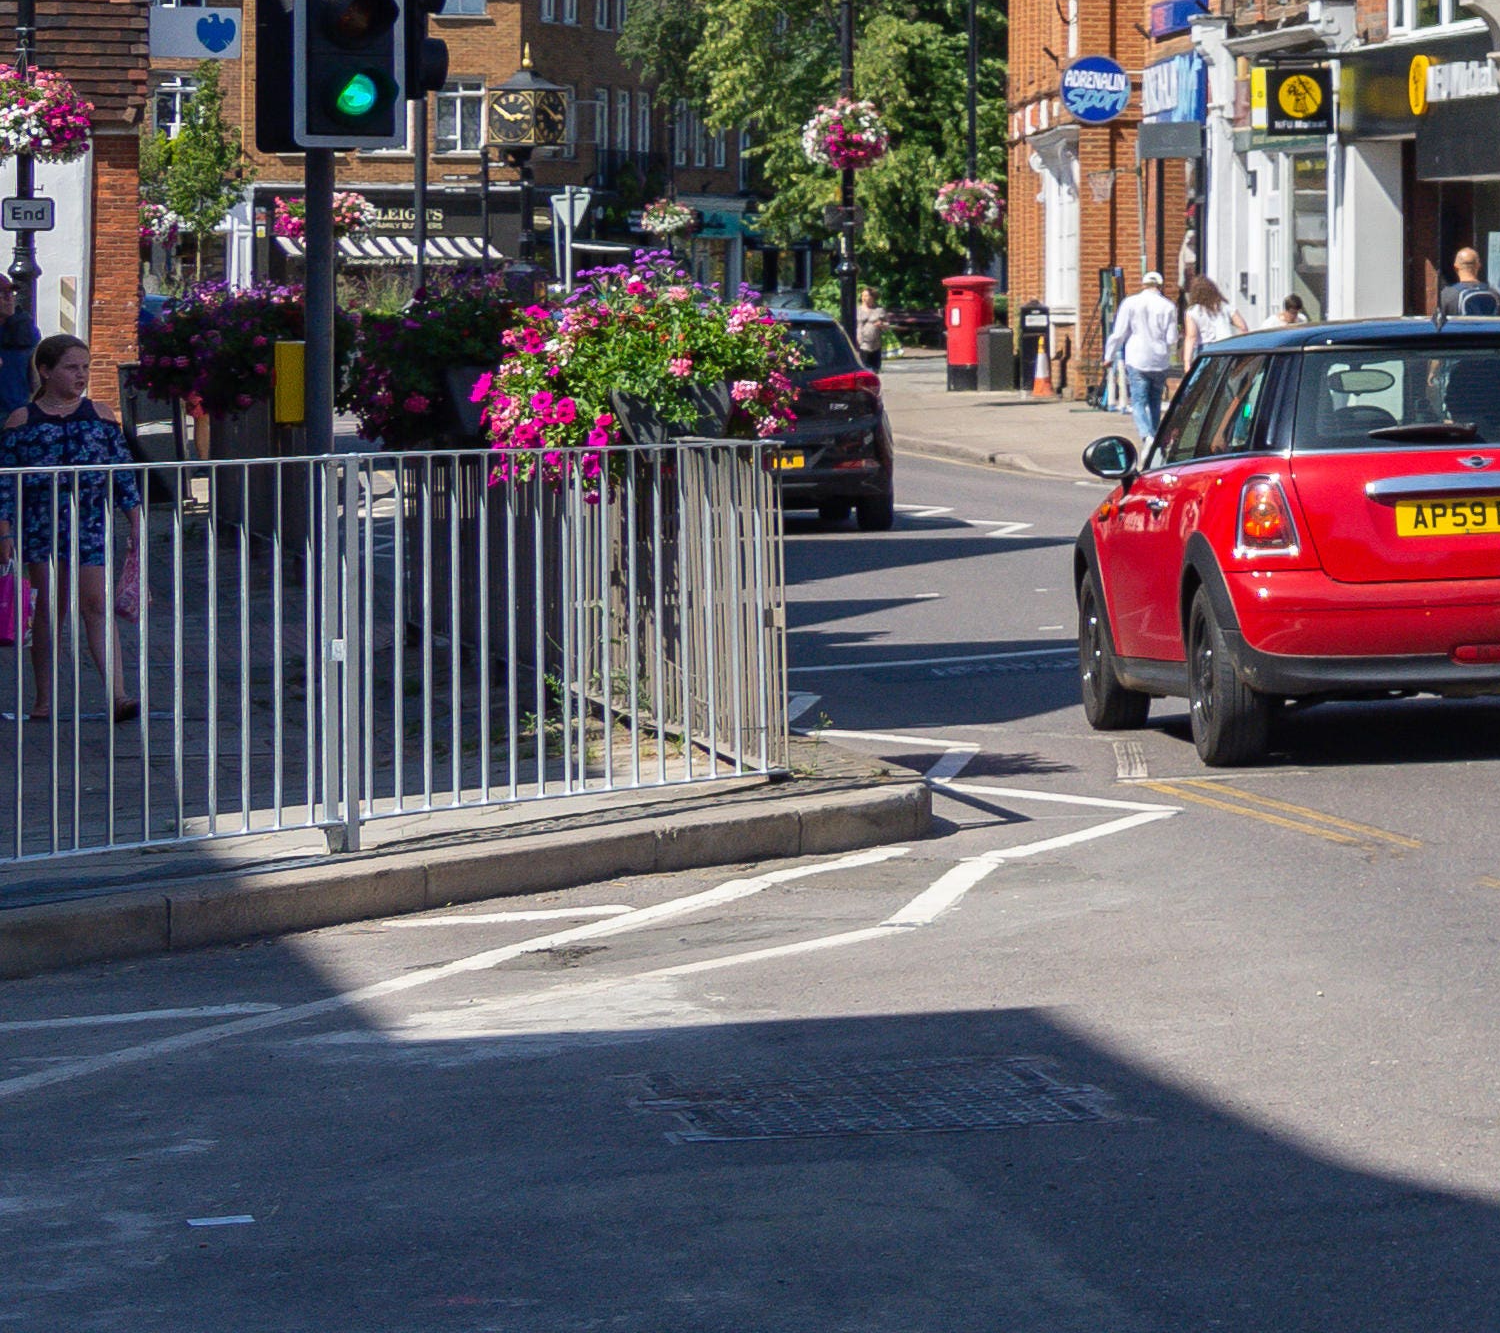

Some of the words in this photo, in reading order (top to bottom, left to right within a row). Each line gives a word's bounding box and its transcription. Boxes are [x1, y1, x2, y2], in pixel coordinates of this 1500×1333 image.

[1064, 68, 1126, 90] ADRENALIN
[12, 207, 44, 220] End
[1414, 501, 1487, 529] AP59
